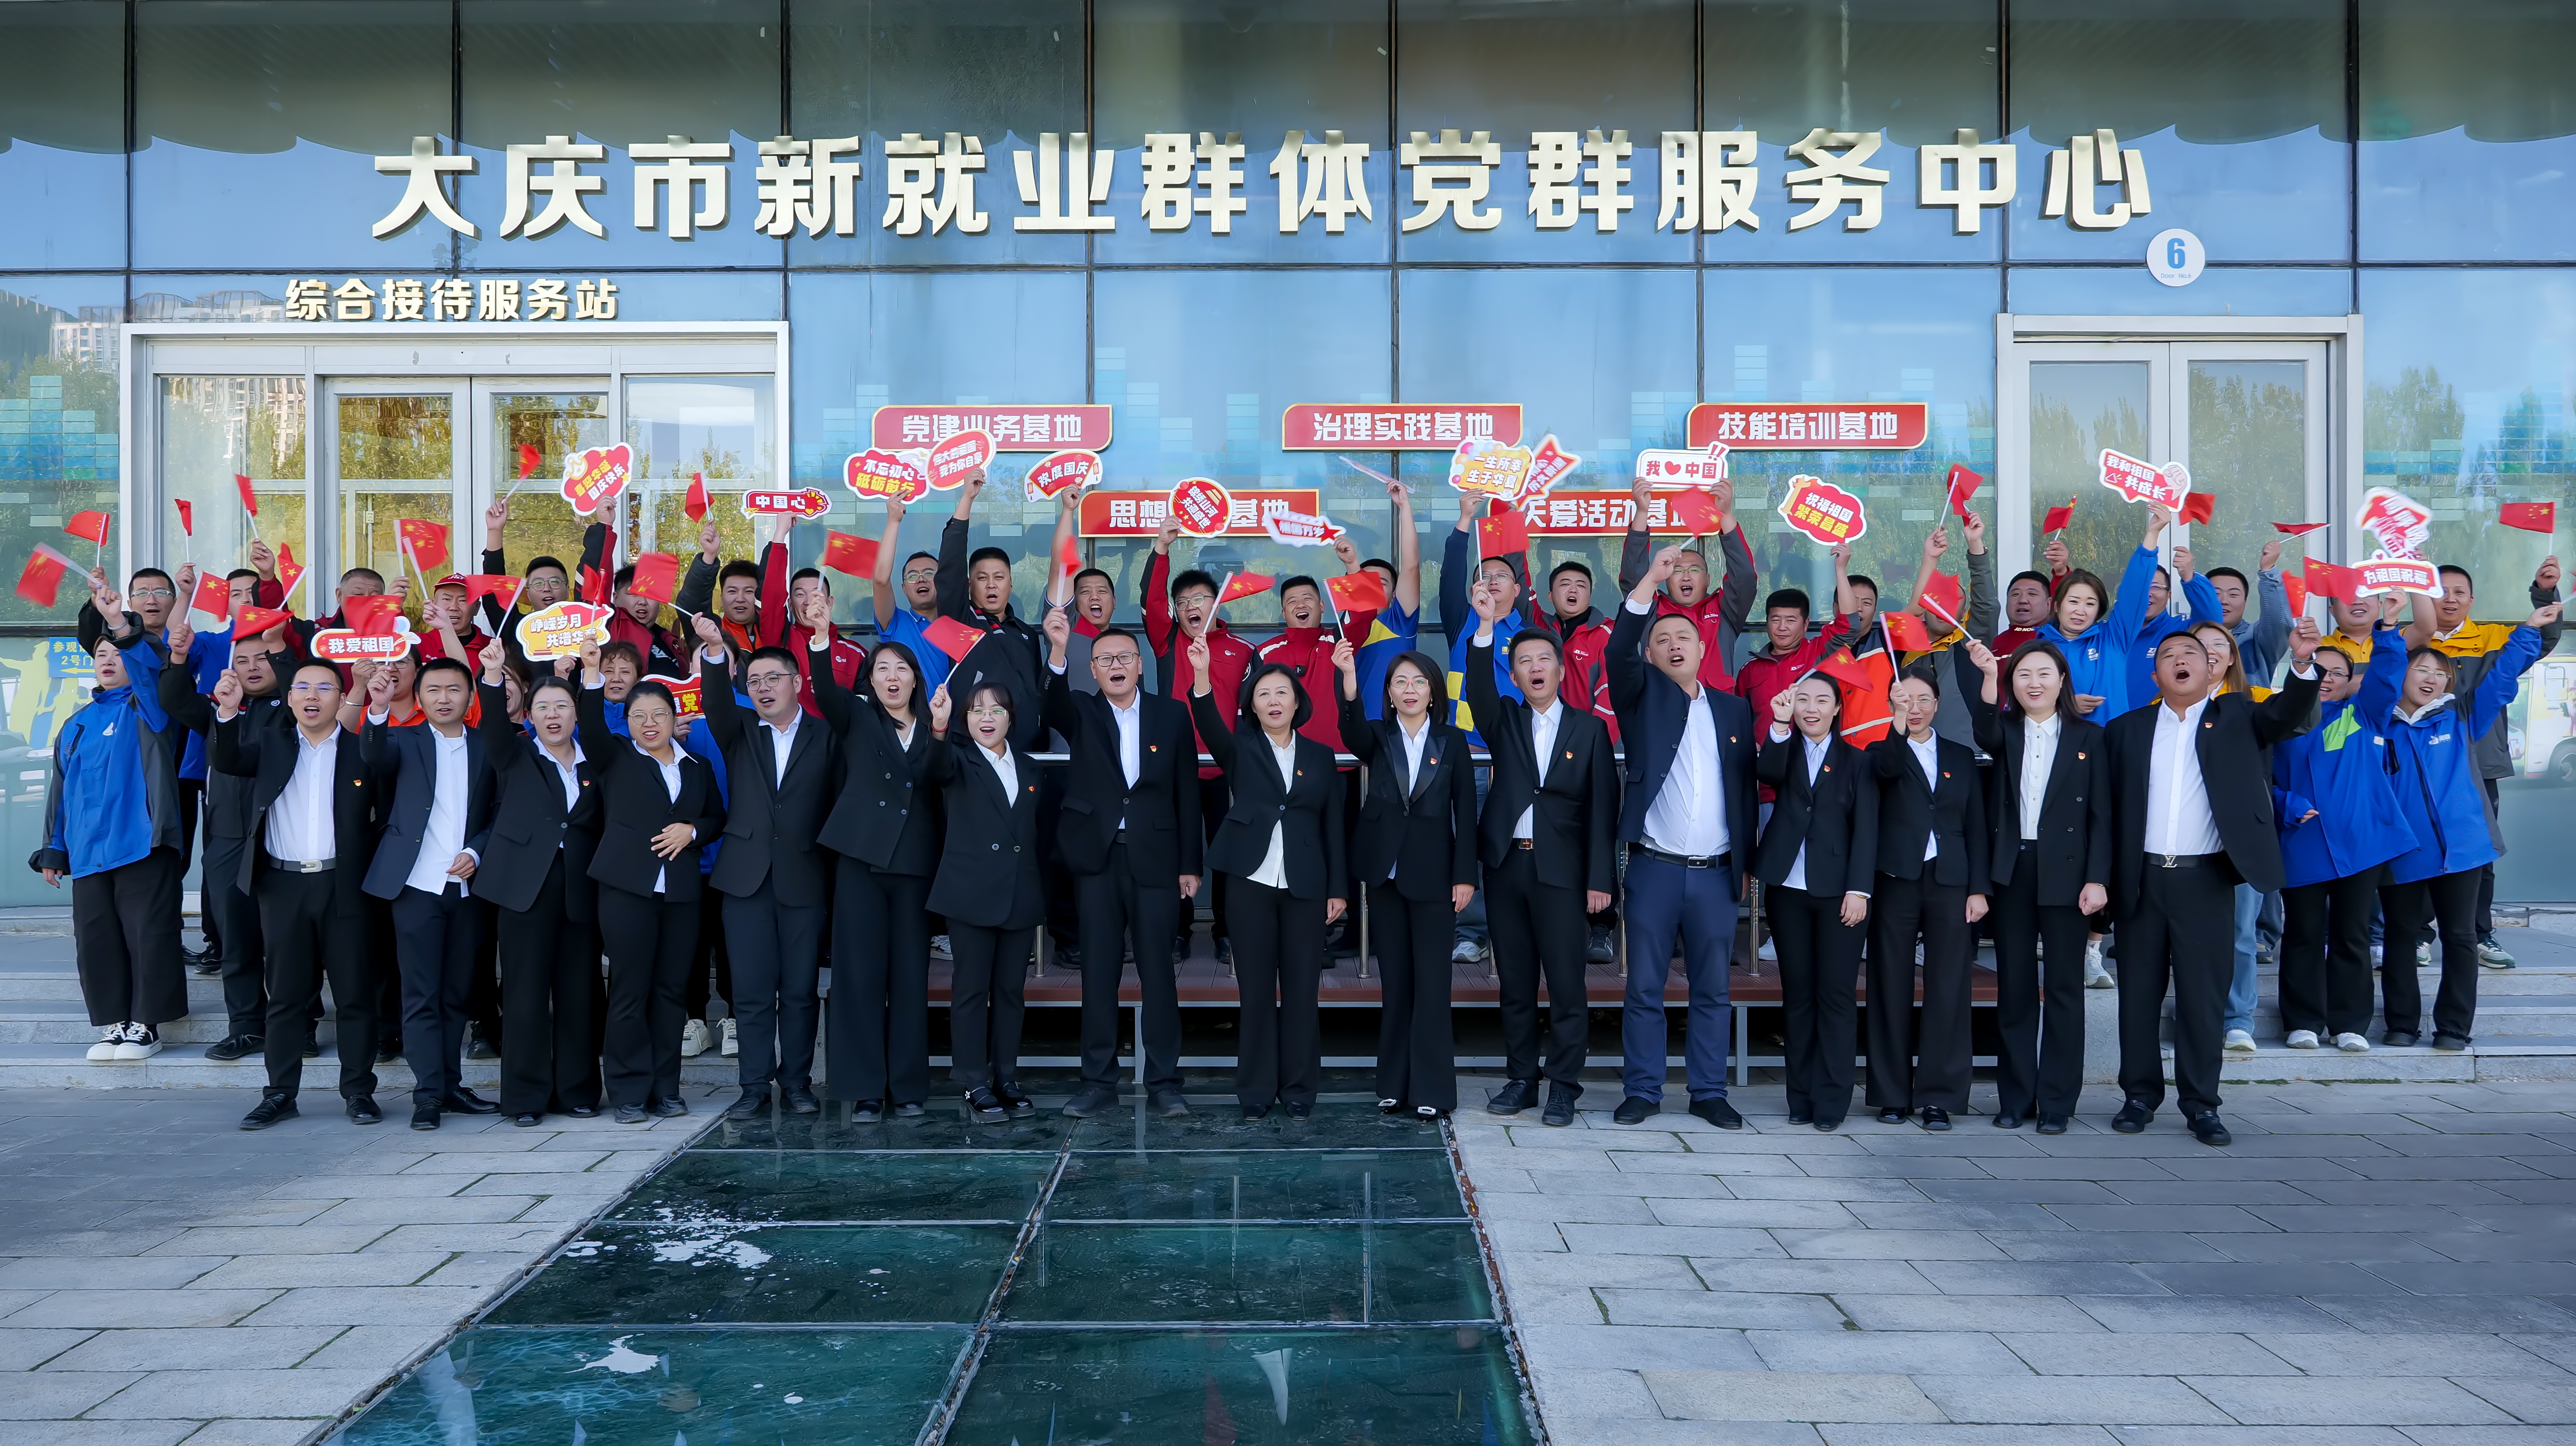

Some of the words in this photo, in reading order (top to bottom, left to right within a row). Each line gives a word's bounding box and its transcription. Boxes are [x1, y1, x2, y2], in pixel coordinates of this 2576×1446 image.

[372, 128, 2152, 239] 大庆市新就业群体党群服务中心
[2167, 238, 2185, 269] 6
[285, 278, 619, 321] 综合接待服务站
[902, 414, 1082, 442] 党建业务基地
[1313, 412, 1493, 441] 治理实践基地
[1718, 412, 1898, 440] 技能培训基地
[863, 459, 914, 481] 不忘初心
[1037, 461, 1089, 487] 欢度国庆
[1474, 455, 1523, 473] 一生所幸
[1646, 460, 1660, 476] 我
[1685, 462, 1717, 479] 中国
[2106, 454, 2156, 482] 我和祖国
[587, 463, 626, 501] 国庆快乐
[855, 472, 915, 497] 砥砺前行
[1466, 469, 1519, 489] 生于华夏
[2125, 475, 2166, 501] 共成长
[756, 495, 806, 510] 中国心
[1109, 499, 1289, 528] 思想基地
[1181, 497, 1211, 529] 共迎盛世
[1187, 486, 1219, 518] 锦绣山河
[1525, 499, 1688, 527] 关爱活动基
[1805, 492, 1854, 523] 祝福祖国
[1794, 503, 1850, 538] 繁荣昌盛
[2363, 568, 2428, 586] 为祖国祝福
[530, 613, 582, 633] 峥嵘岁月
[328, 637, 394, 654] 我爱祖国
[61, 655, 93, 666] 2号门
